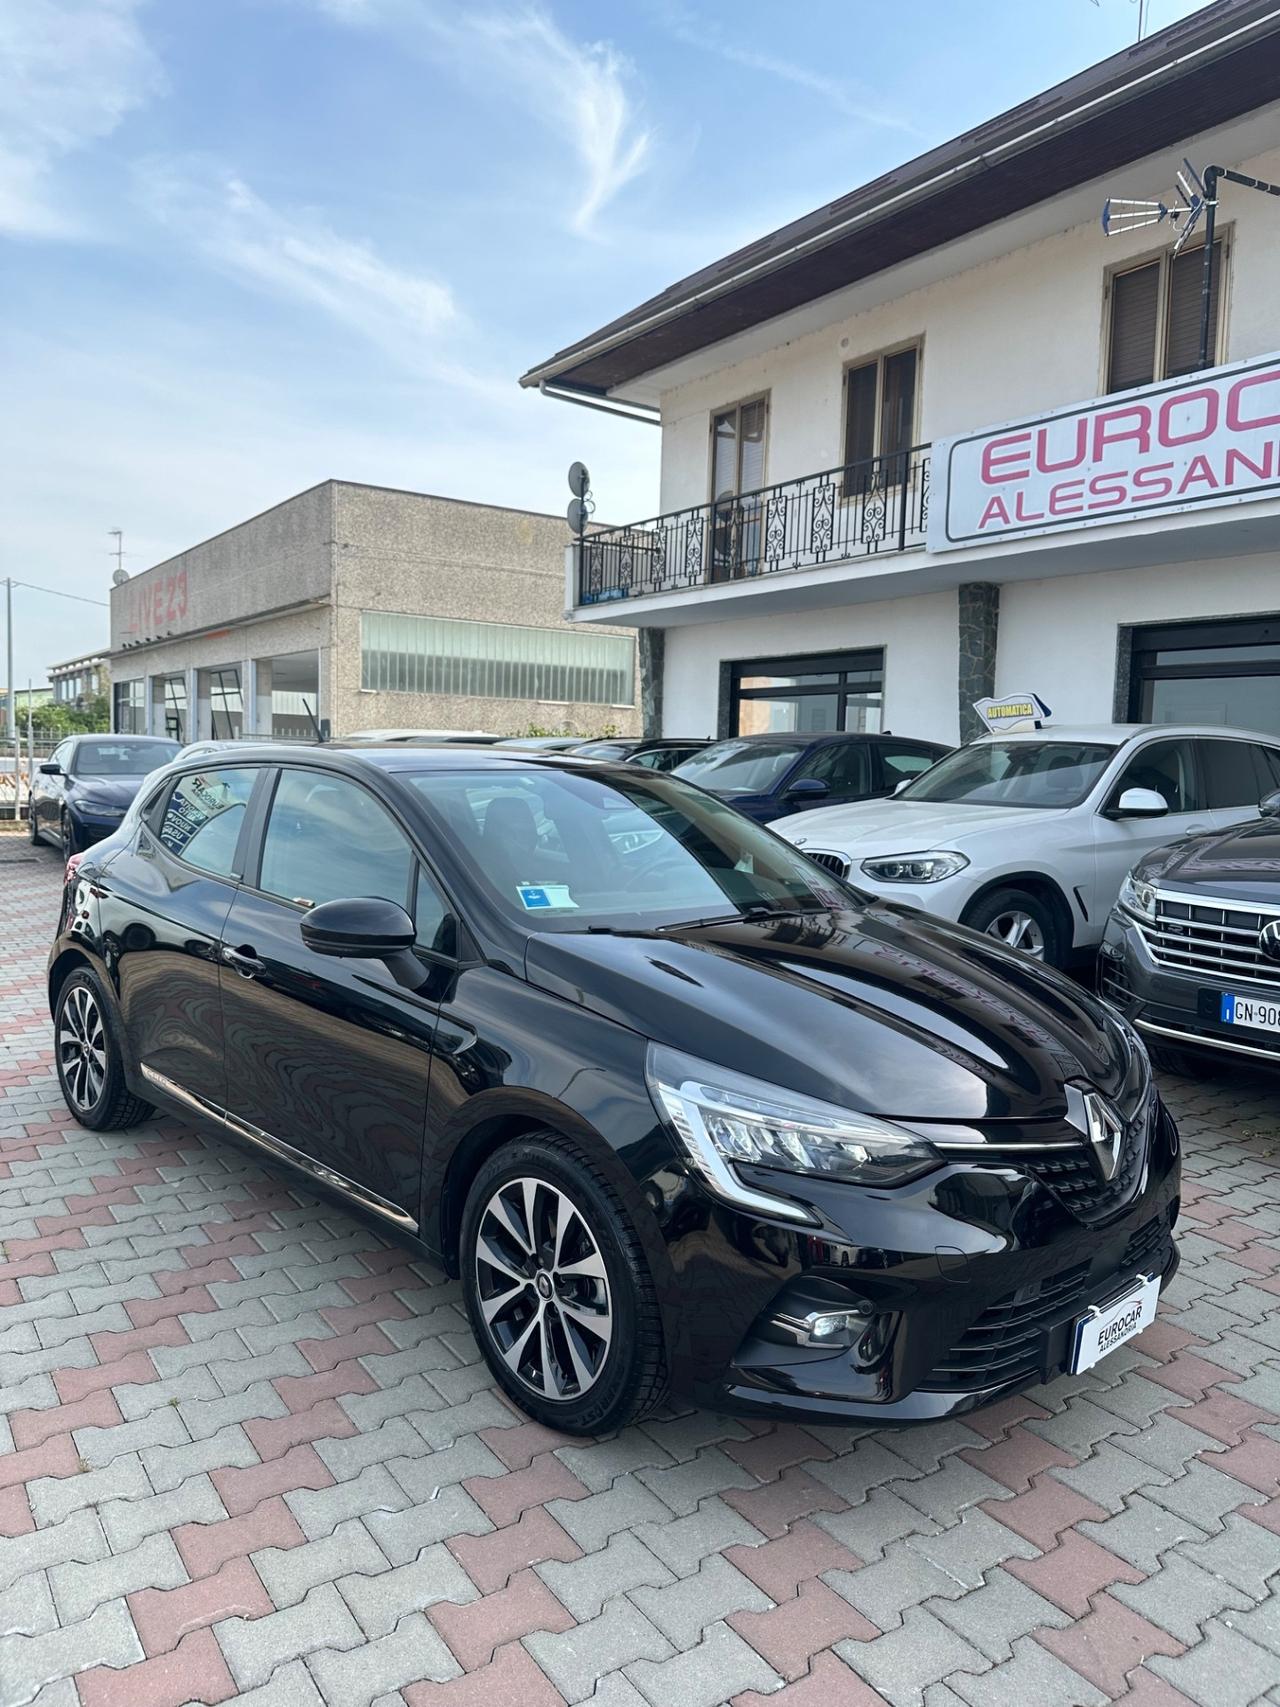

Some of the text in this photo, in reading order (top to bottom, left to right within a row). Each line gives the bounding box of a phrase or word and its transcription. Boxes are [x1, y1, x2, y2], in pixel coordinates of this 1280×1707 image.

[980, 369, 1280, 485] EUROC
[977, 440, 1280, 529] ALESSAN
[987, 703, 1033, 719] AUTOMATICA
[1097, 1306, 1142, 1346] EUROCAR
[1099, 1322, 1137, 1352] ALESSANDRIA
